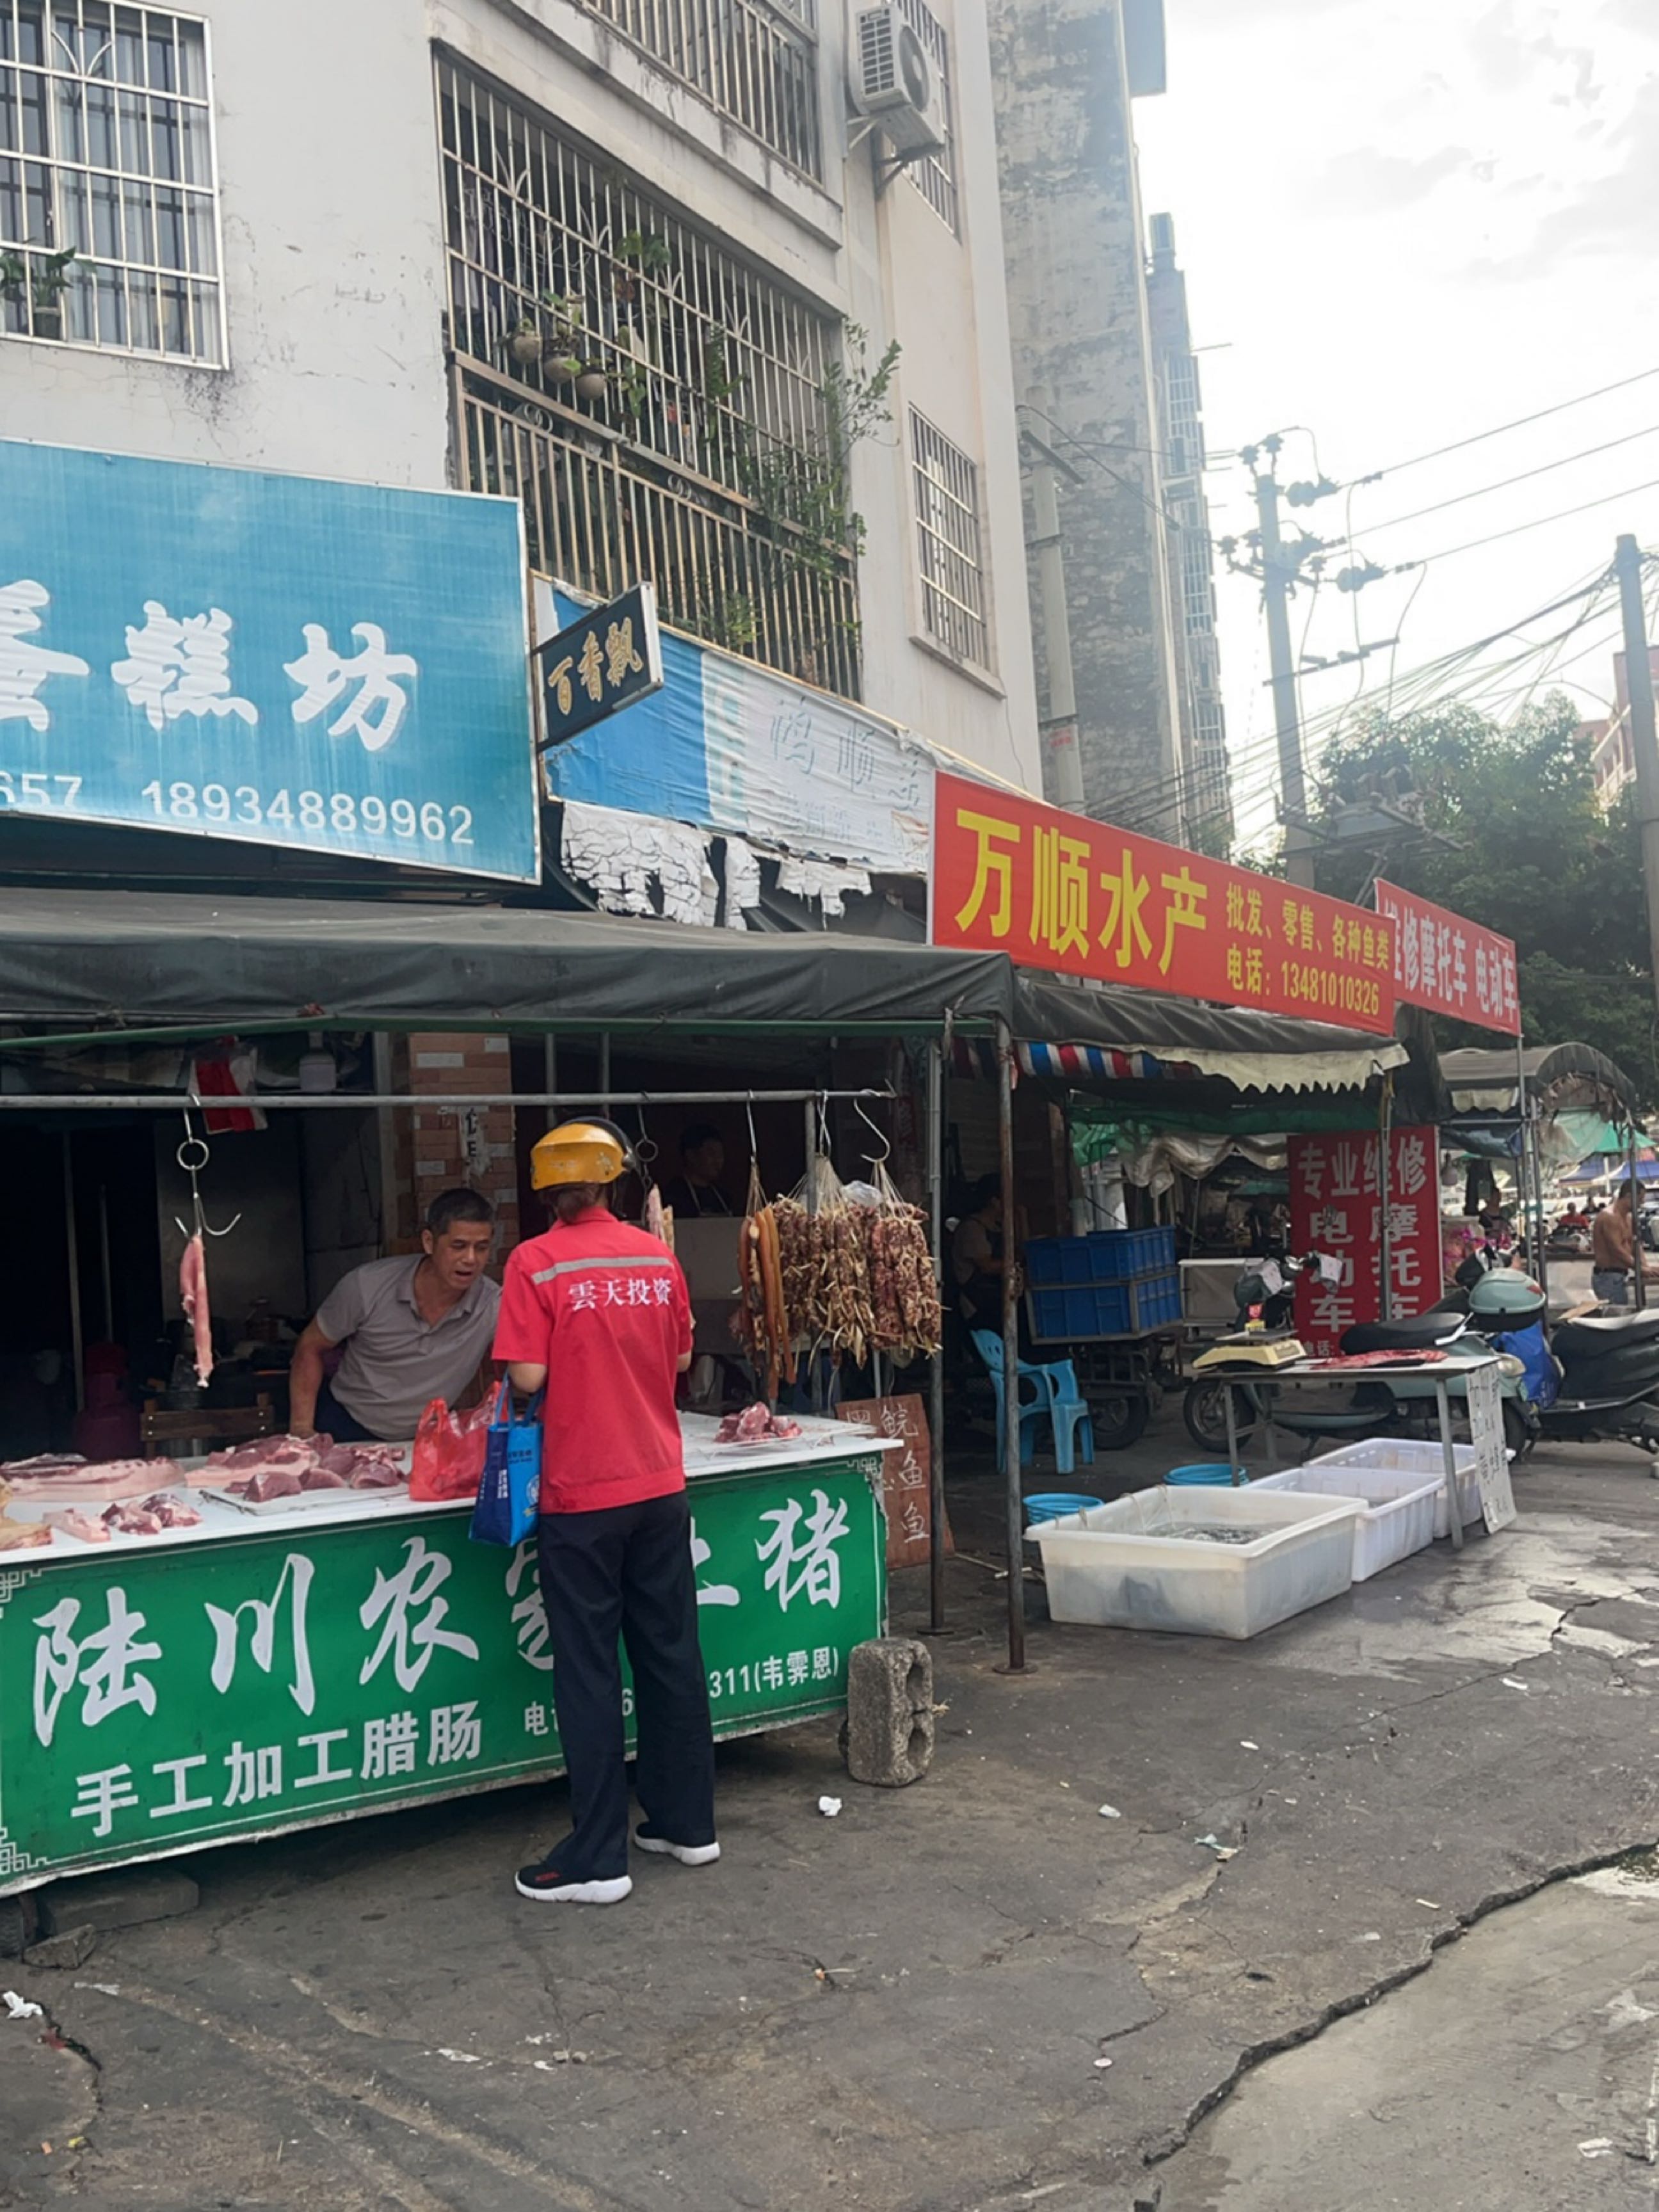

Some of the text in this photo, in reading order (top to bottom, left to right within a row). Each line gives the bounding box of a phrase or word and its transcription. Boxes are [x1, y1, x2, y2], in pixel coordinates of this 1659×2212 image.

[142, 780, 474, 845] 18934889962
[955, 808, 1208, 976] 万顺水产
[1475, 939, 1516, 1023] 电动车
[1298, 1135, 1427, 1199] 专业维修
[71, 1701, 482, 1838] 手工加工腊肠
